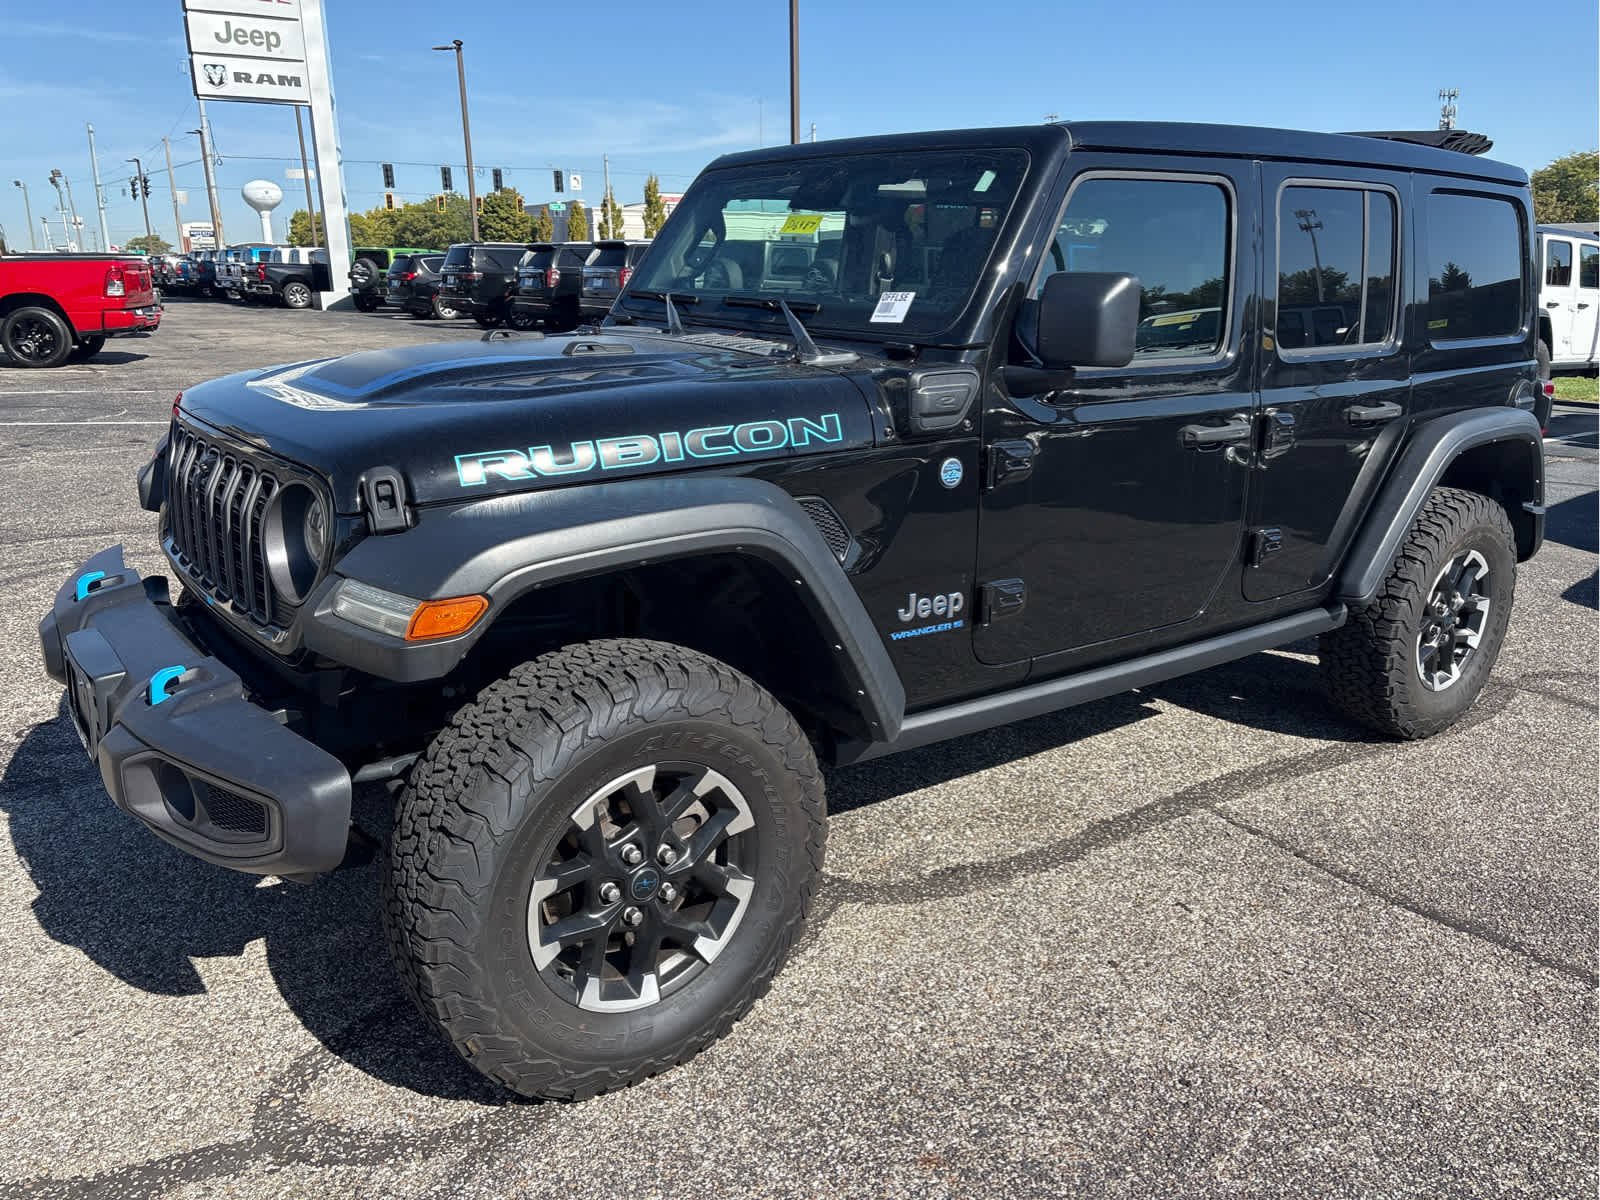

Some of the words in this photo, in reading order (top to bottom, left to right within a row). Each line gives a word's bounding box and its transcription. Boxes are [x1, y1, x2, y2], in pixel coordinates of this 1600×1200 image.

[214, 21, 281, 52] Jeep
[233, 71, 302, 88] RAM
[454, 413, 843, 487] RUBICON
[897, 591, 964, 622] Jeep
[890, 622, 952, 640] WRANGLER
